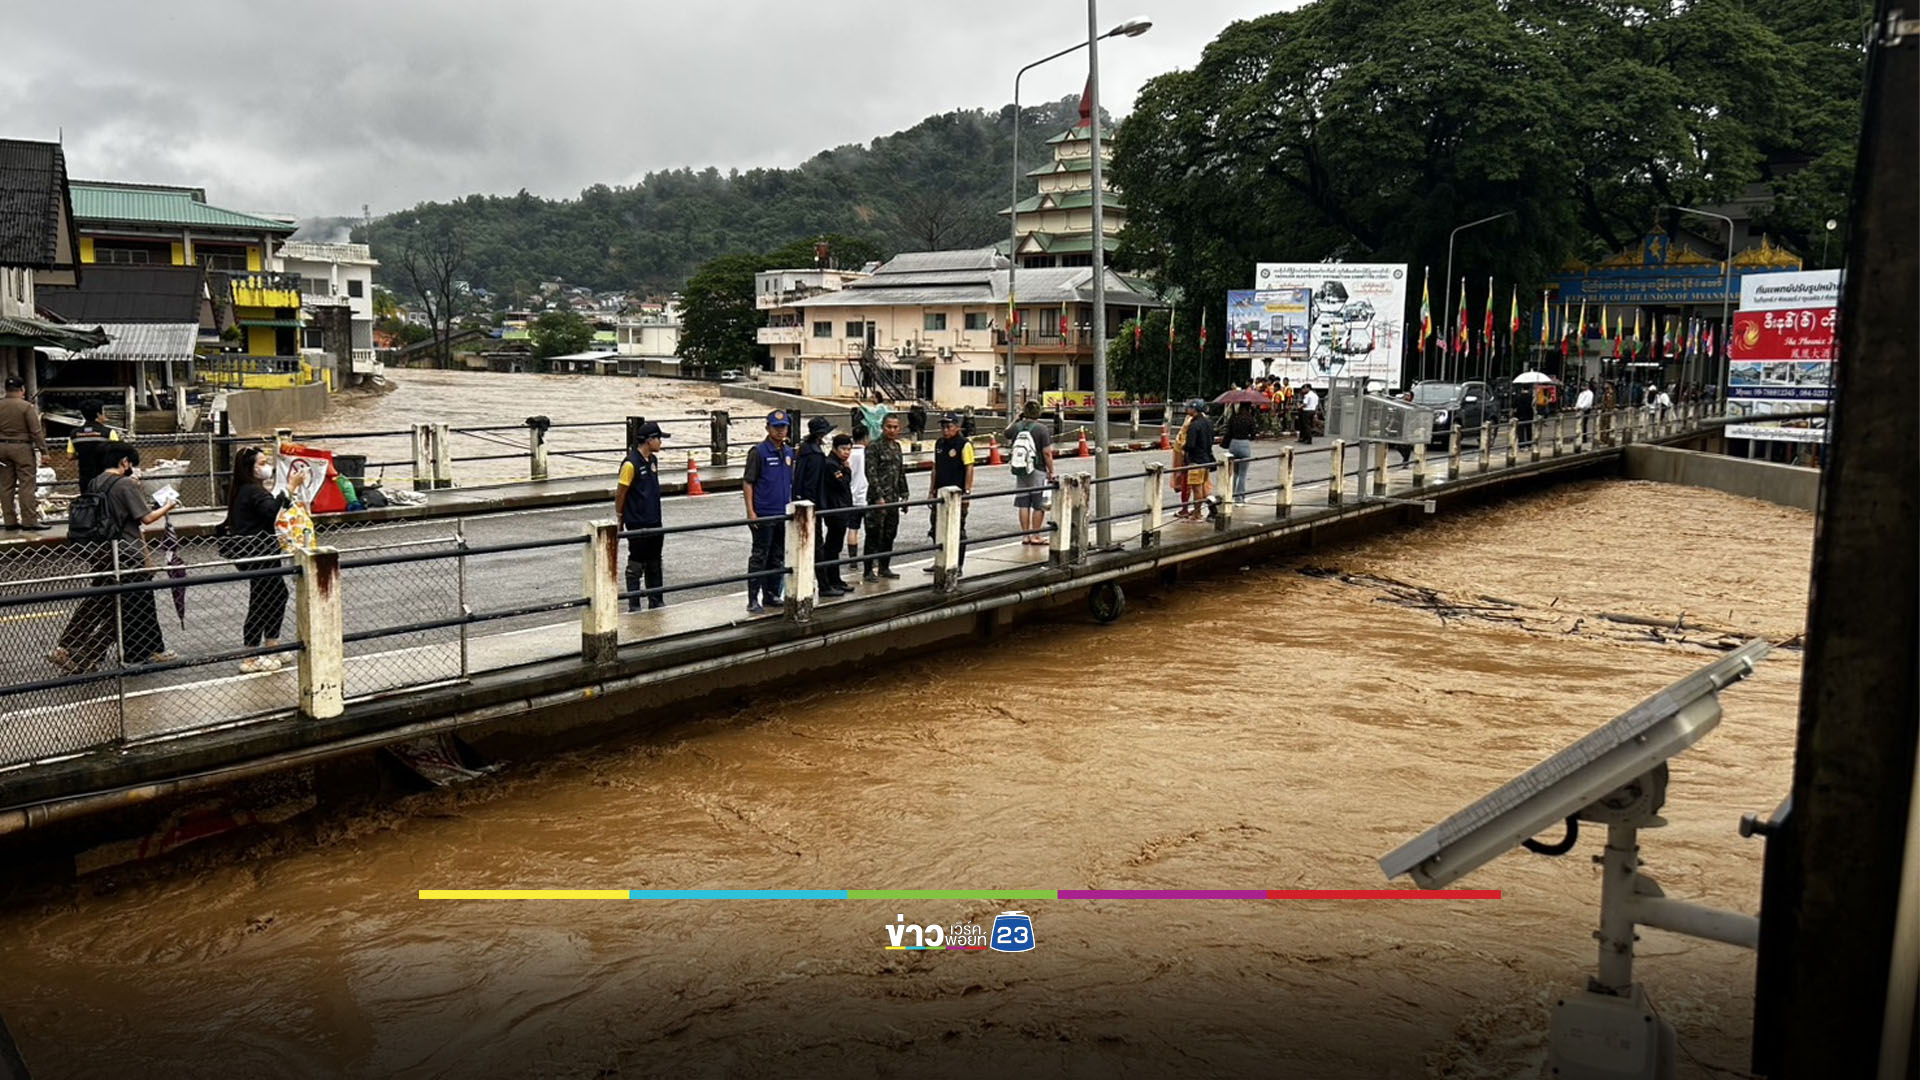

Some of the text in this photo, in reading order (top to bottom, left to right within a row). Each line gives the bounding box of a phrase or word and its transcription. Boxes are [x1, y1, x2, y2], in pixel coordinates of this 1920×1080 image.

[1609, 293, 1622, 302] OF
[1624, 293, 1642, 302] THE
[1644, 292, 1674, 301] UNION
[1675, 292, 1688, 301] OF
[1798, 336, 1826, 346] Phoenix
